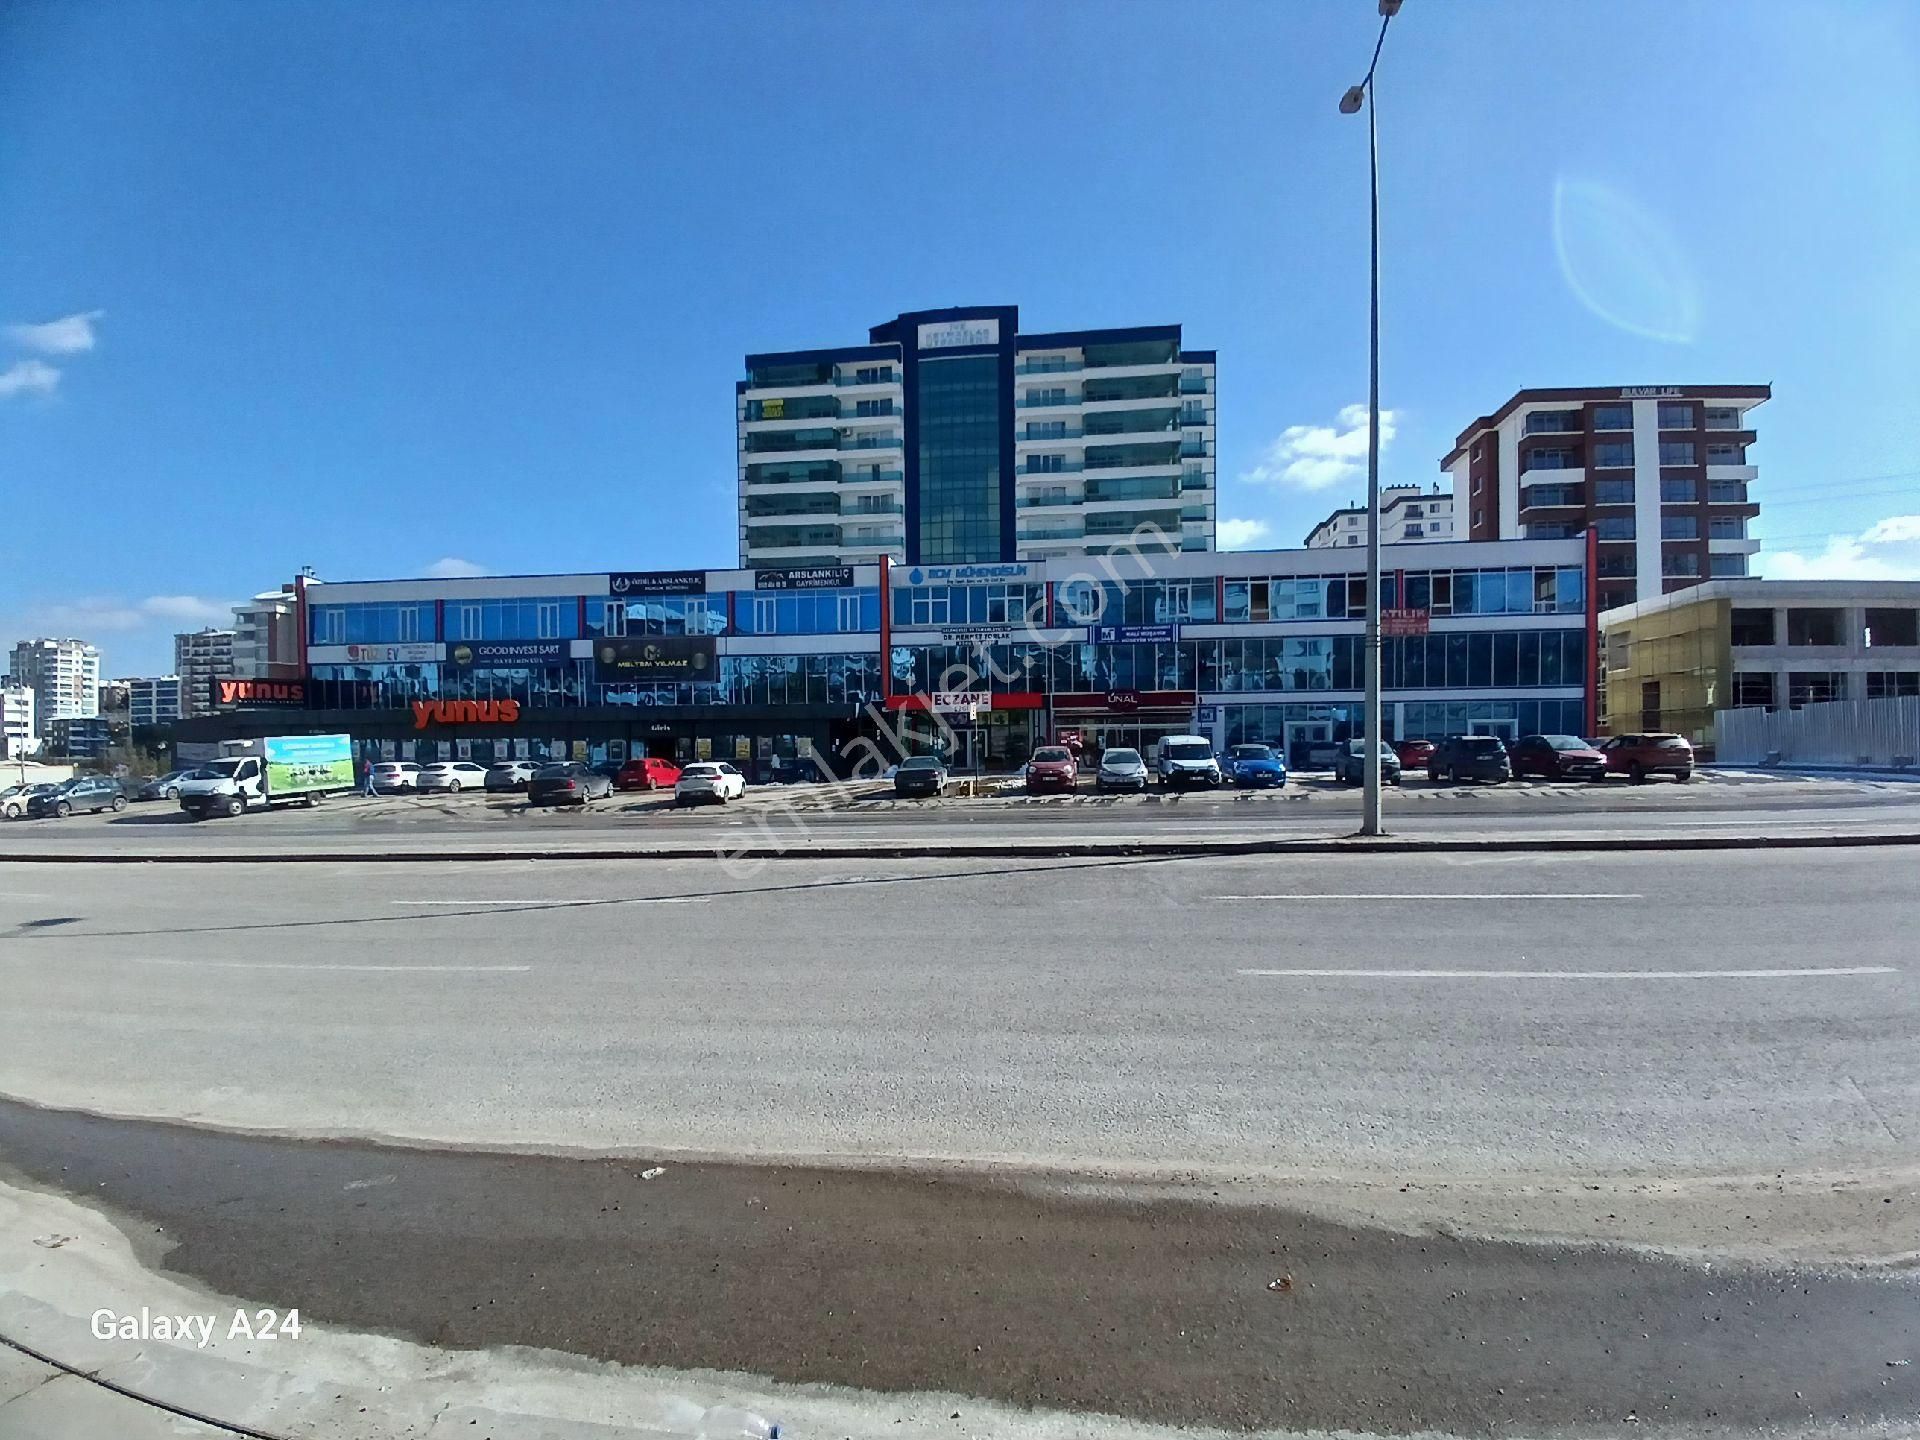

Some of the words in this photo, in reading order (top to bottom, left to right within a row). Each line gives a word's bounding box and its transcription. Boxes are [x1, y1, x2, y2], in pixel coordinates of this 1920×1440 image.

[479, 646, 508, 655] GOOD
[221, 682, 304, 702] yunus
[934, 694, 989, 705] ECZANE
[412, 699, 520, 729] yunus
